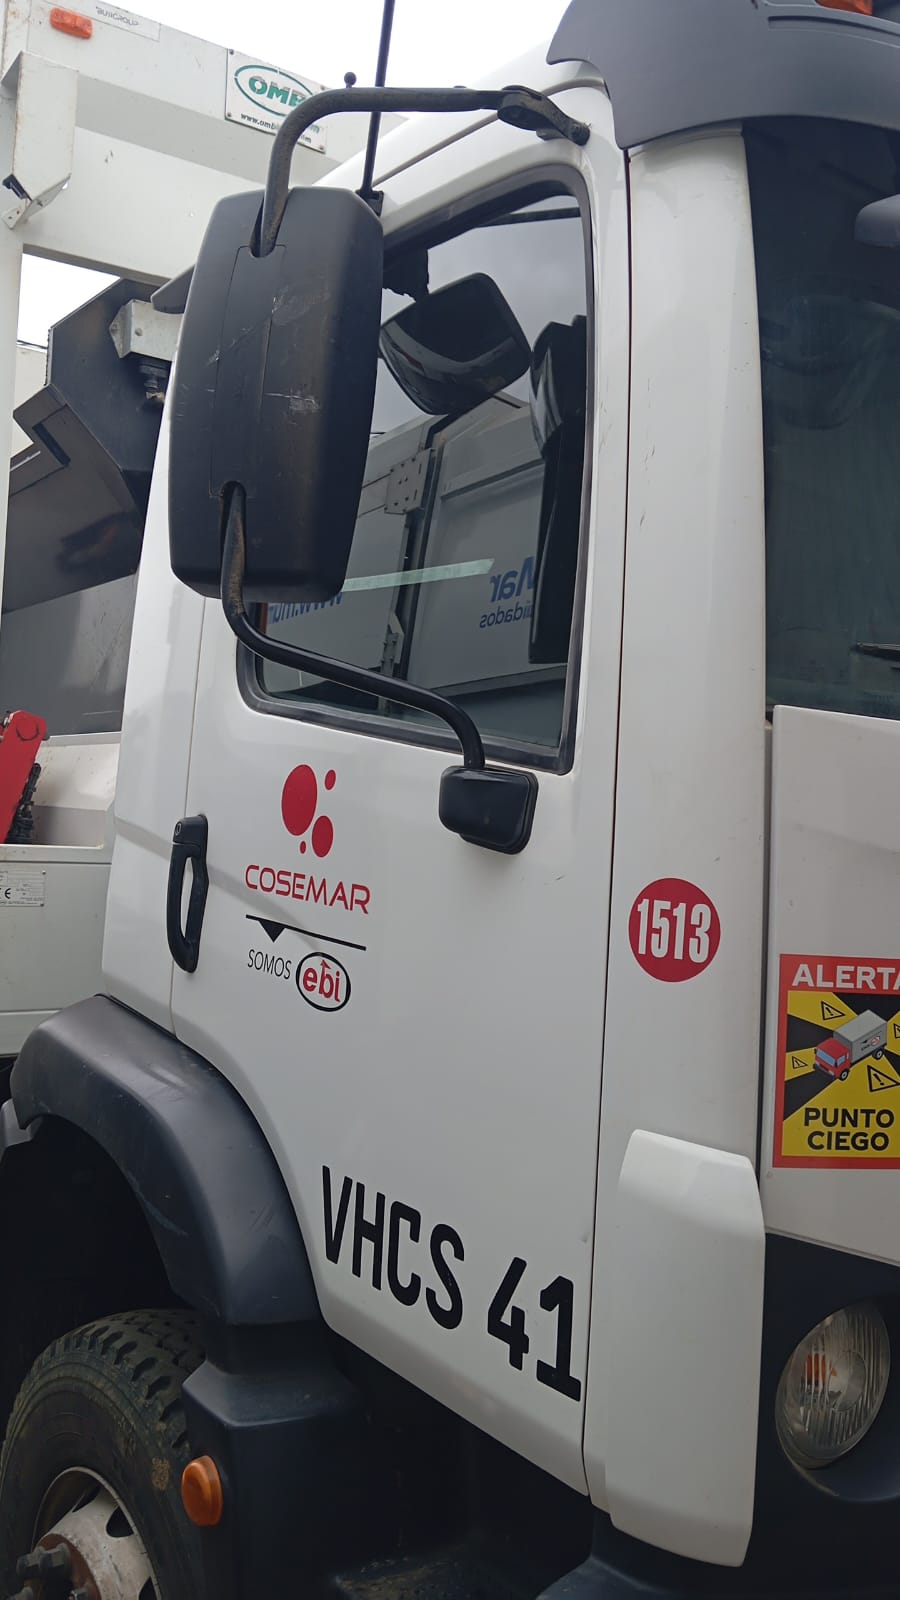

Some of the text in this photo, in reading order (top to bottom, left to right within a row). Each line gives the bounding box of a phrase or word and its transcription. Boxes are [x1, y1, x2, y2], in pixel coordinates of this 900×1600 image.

[245, 864, 371, 914] COSEMAR
[637, 898, 712, 964] 1513
[247, 948, 341, 1003] SOMOS ebi
[804, 1107, 895, 1128] PUNTO
[807, 1130, 890, 1152] CIEGO
[322, 1164, 582, 1403] VHCS 41
